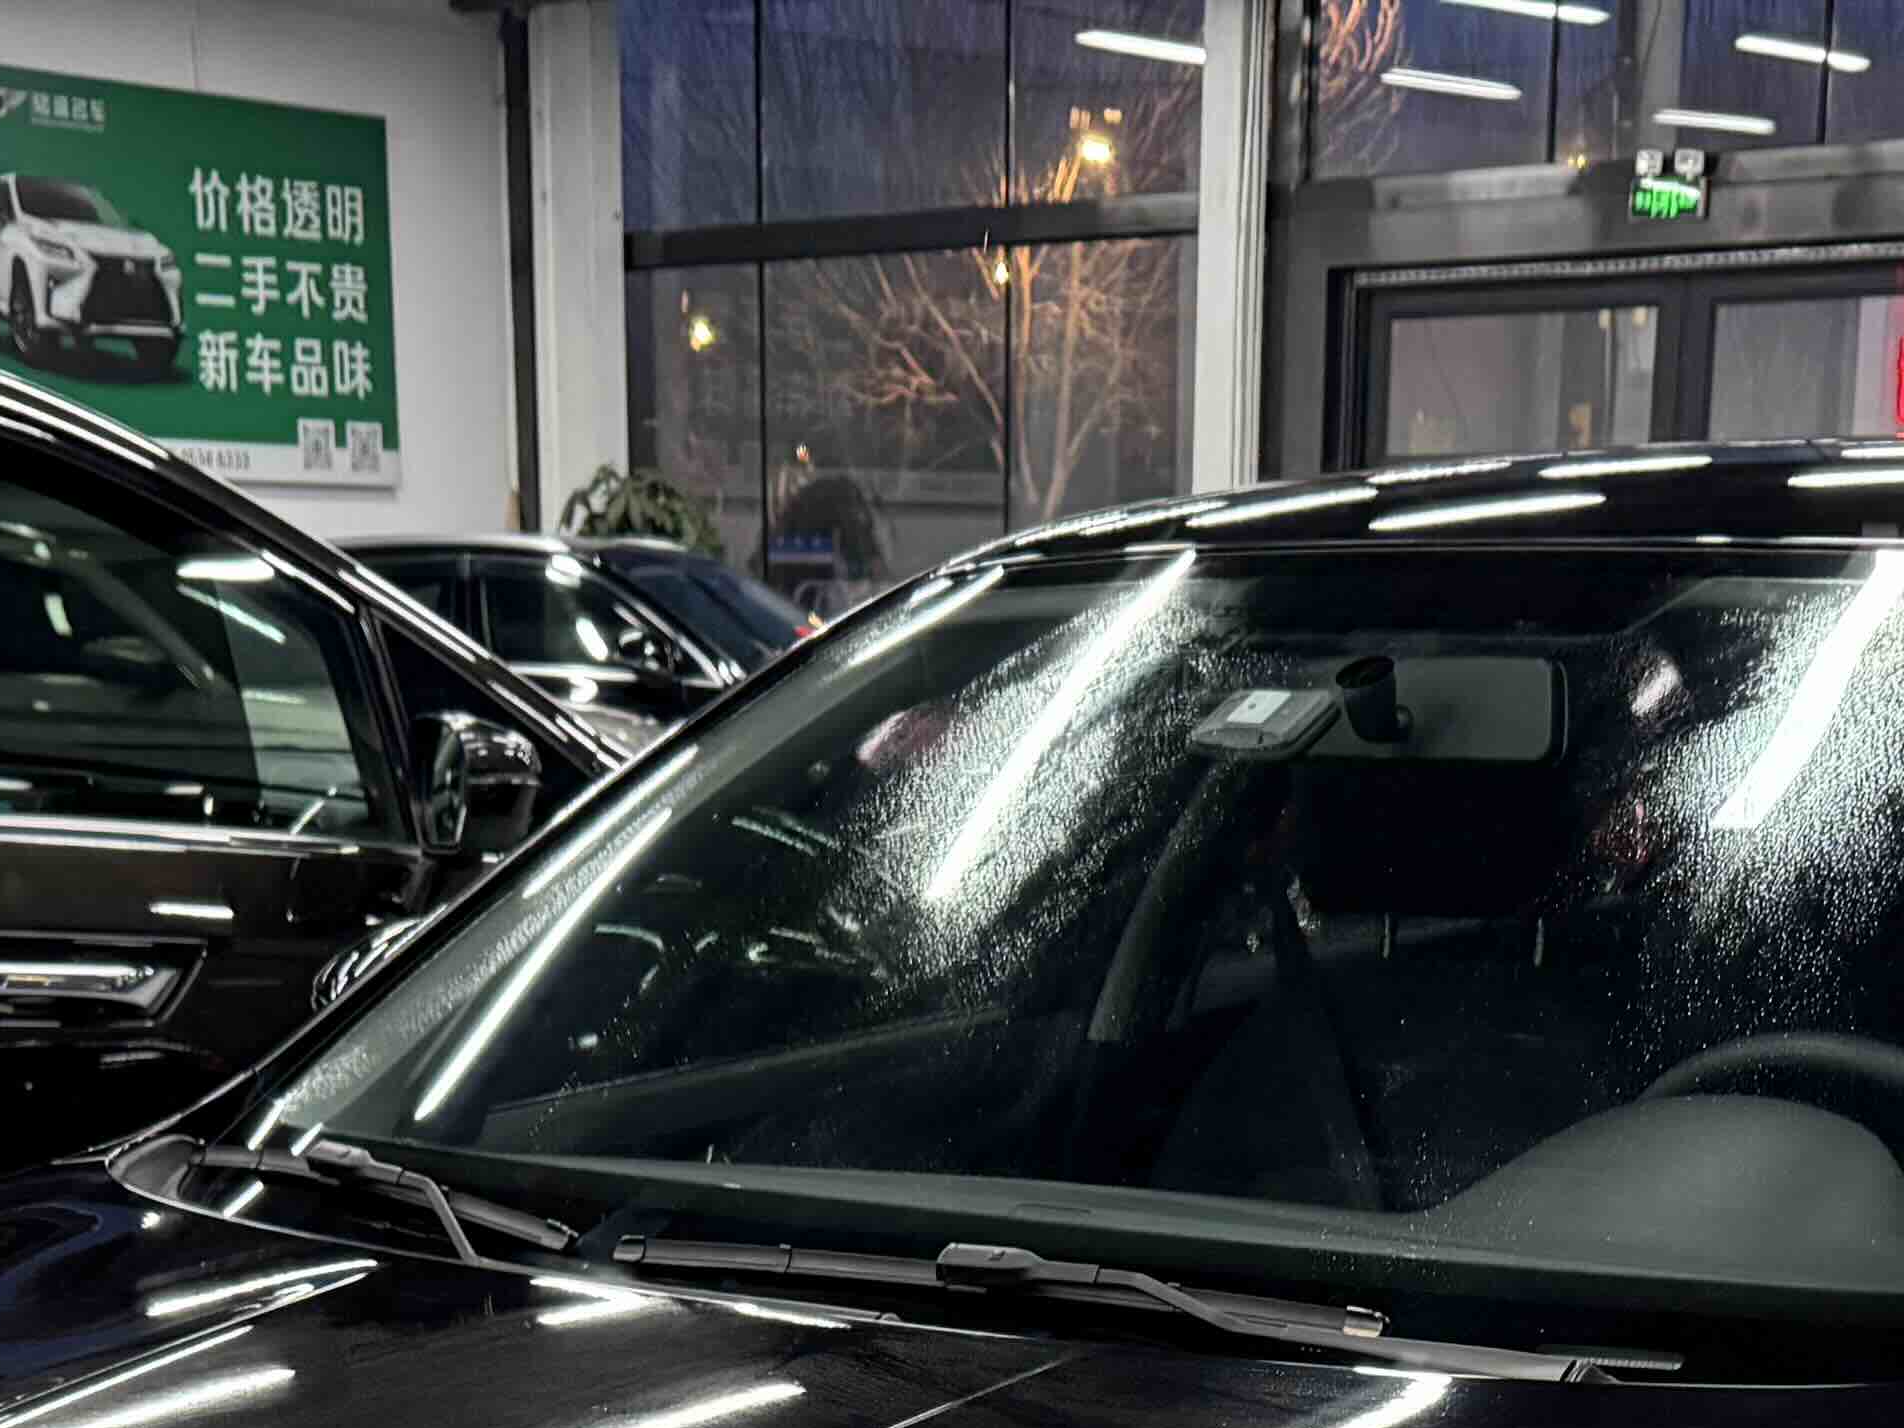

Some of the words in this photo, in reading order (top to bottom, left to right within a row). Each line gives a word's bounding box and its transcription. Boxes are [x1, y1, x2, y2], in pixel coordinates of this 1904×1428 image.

[189, 167, 365, 247] 价格透明
[194, 252, 369, 323] 二手不贵
[198, 328, 373, 400] 新车品味
